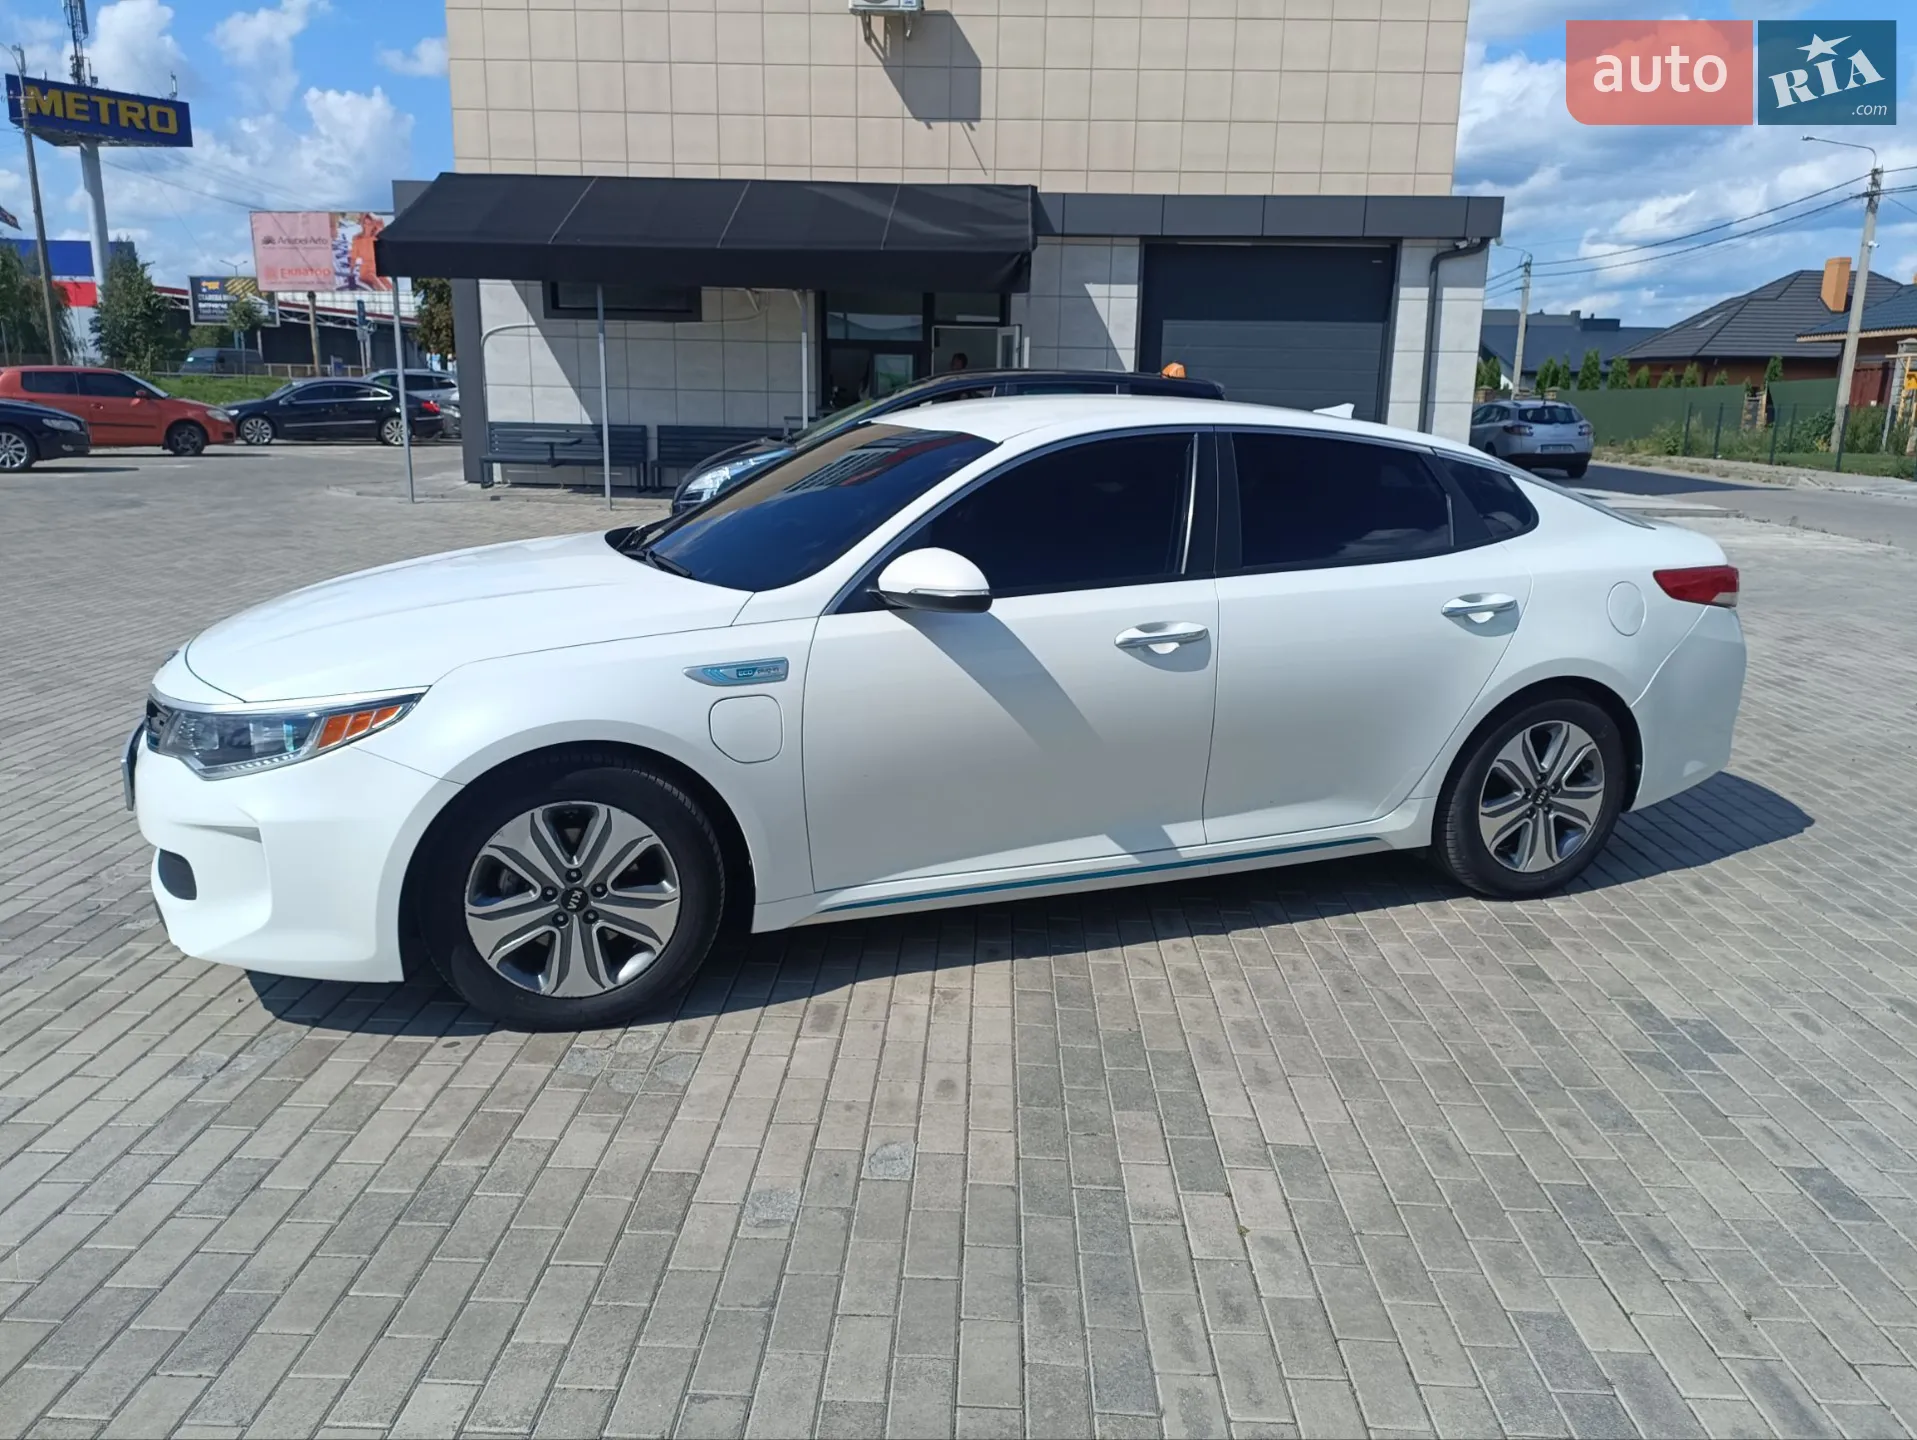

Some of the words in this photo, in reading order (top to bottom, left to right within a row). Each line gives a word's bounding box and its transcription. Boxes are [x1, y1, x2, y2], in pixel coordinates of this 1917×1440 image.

[24, 85, 179, 135] METRO
[1535, 789, 1548, 804] KIA
[567, 890, 583, 909] KIA
